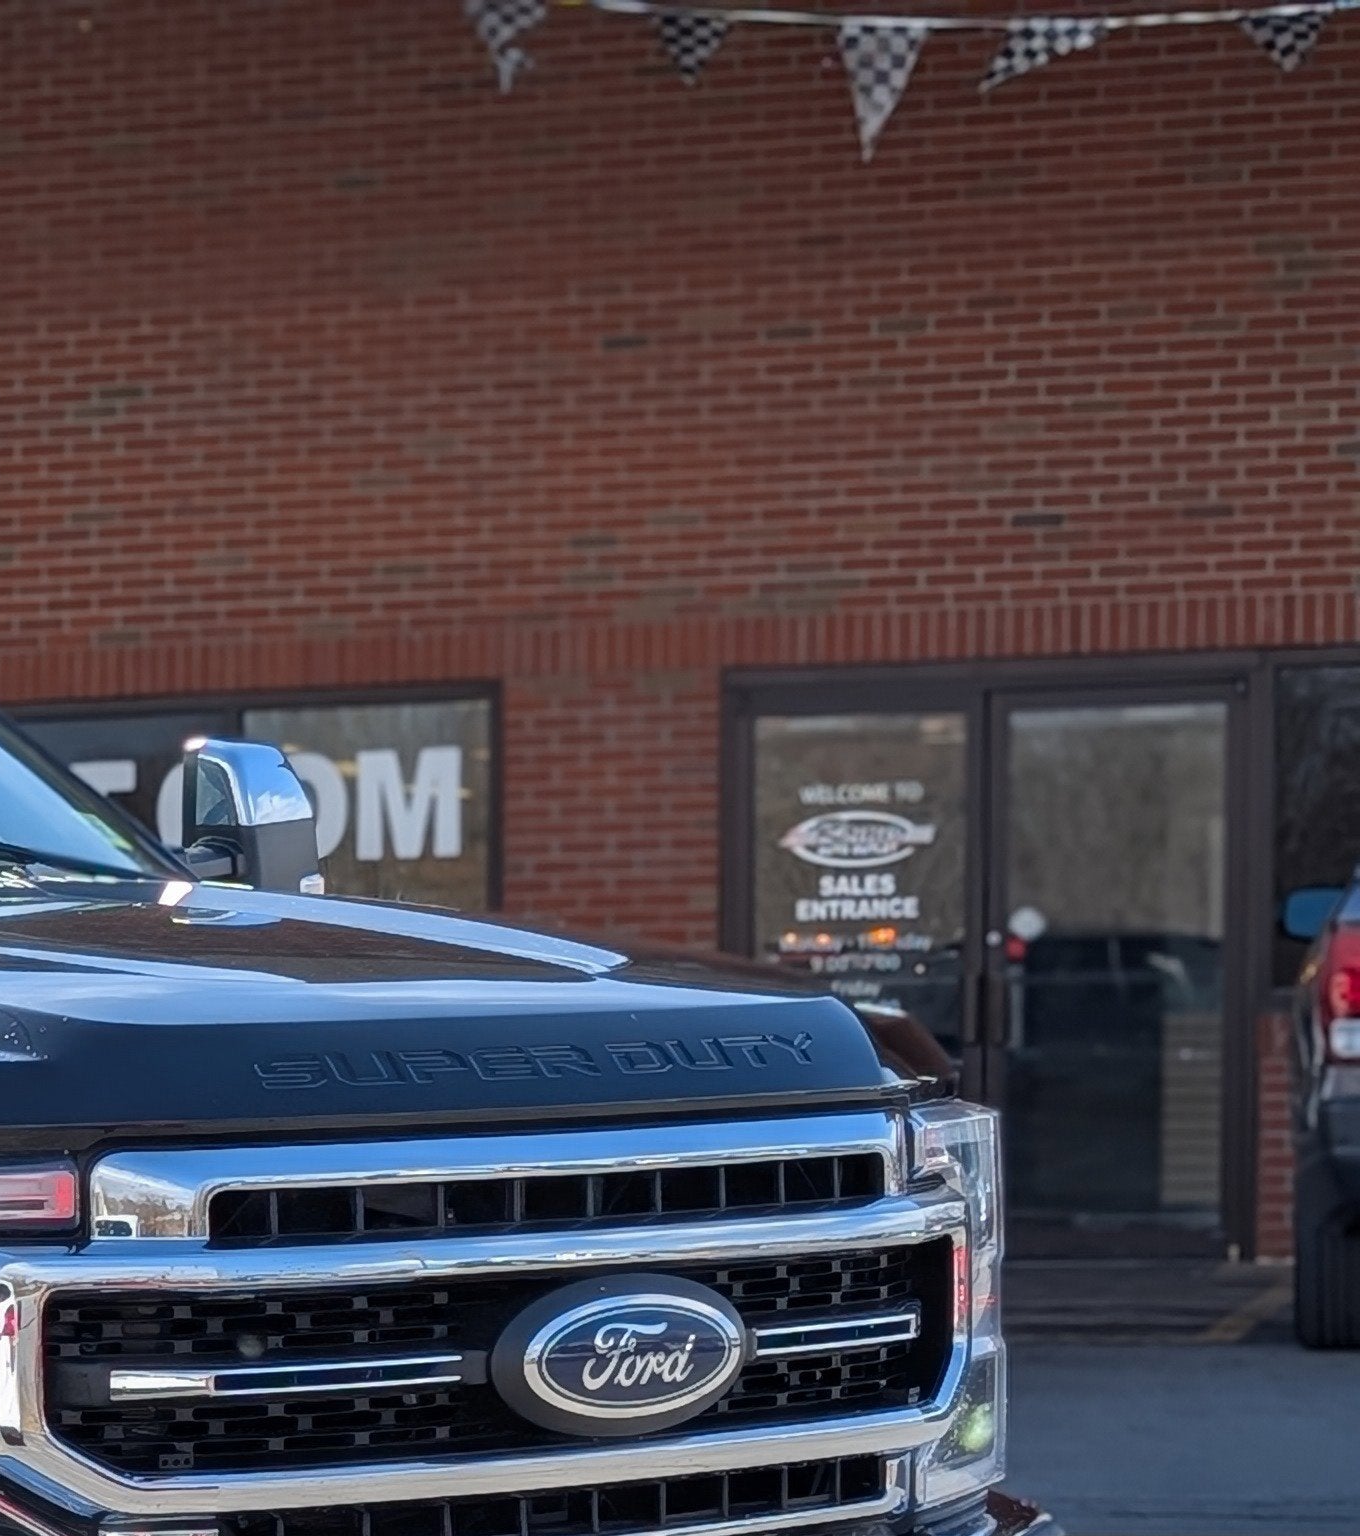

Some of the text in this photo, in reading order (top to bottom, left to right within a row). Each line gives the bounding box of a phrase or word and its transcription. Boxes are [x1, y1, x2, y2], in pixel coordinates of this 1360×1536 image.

[819, 873, 896, 896] SALES
[795, 896, 920, 922] ENTRANCE
[252, 1031, 814, 1090] SUPER DUTY
[582, 1321, 695, 1391] Ford
